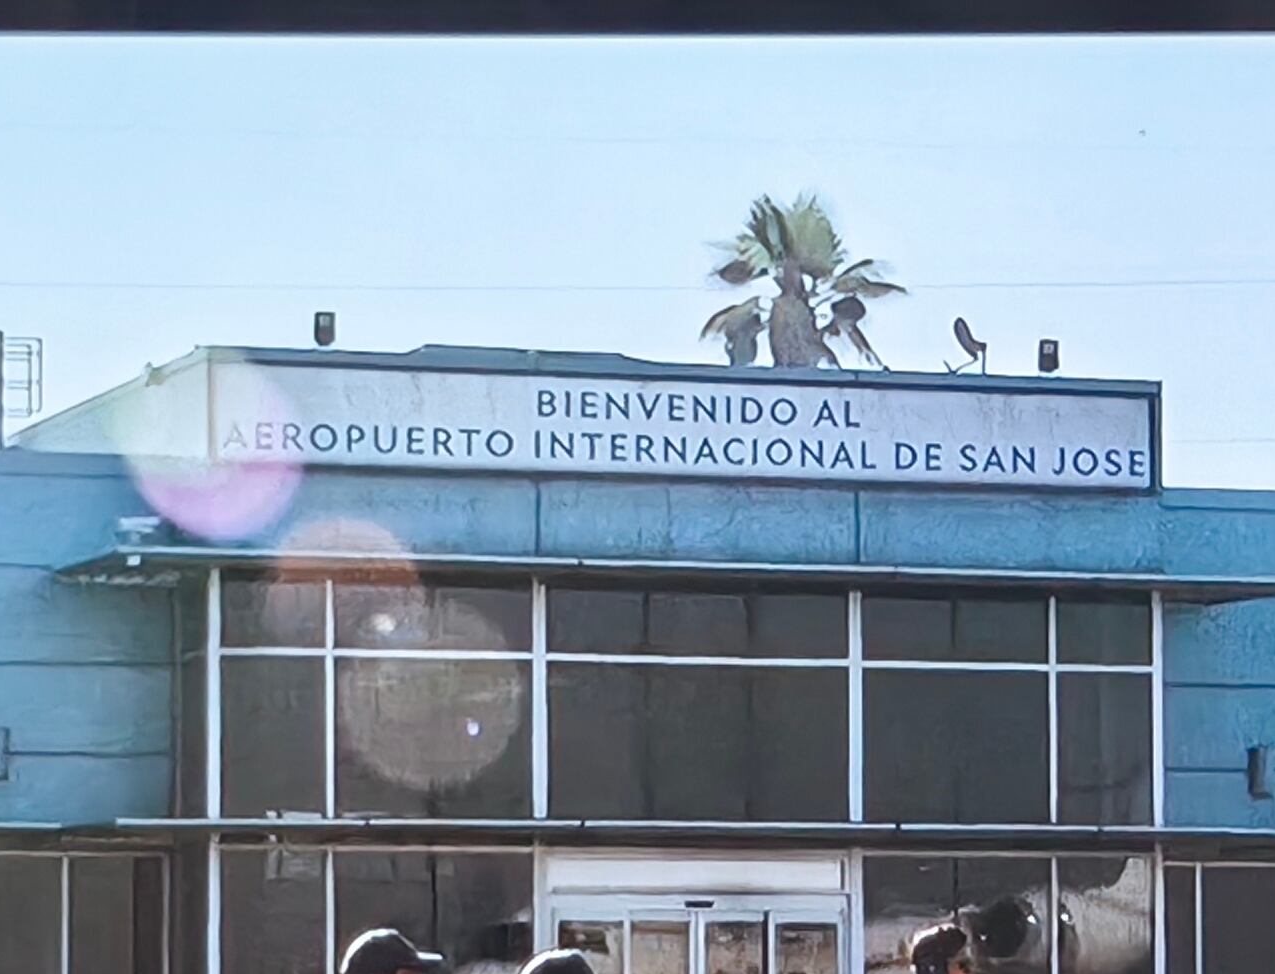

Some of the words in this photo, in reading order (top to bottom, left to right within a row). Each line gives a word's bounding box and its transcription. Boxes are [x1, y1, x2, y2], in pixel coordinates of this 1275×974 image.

[536, 389, 799, 426] BIENVENIDO
[813, 399, 862, 428] AL
[222, 421, 515, 459] AEROPUERTO
[533, 429, 878, 470] INTERNACIONAL
[894, 442, 943, 472] DE
[958, 443, 1037, 475] SAN
[1052, 446, 1146, 478] JOSE
